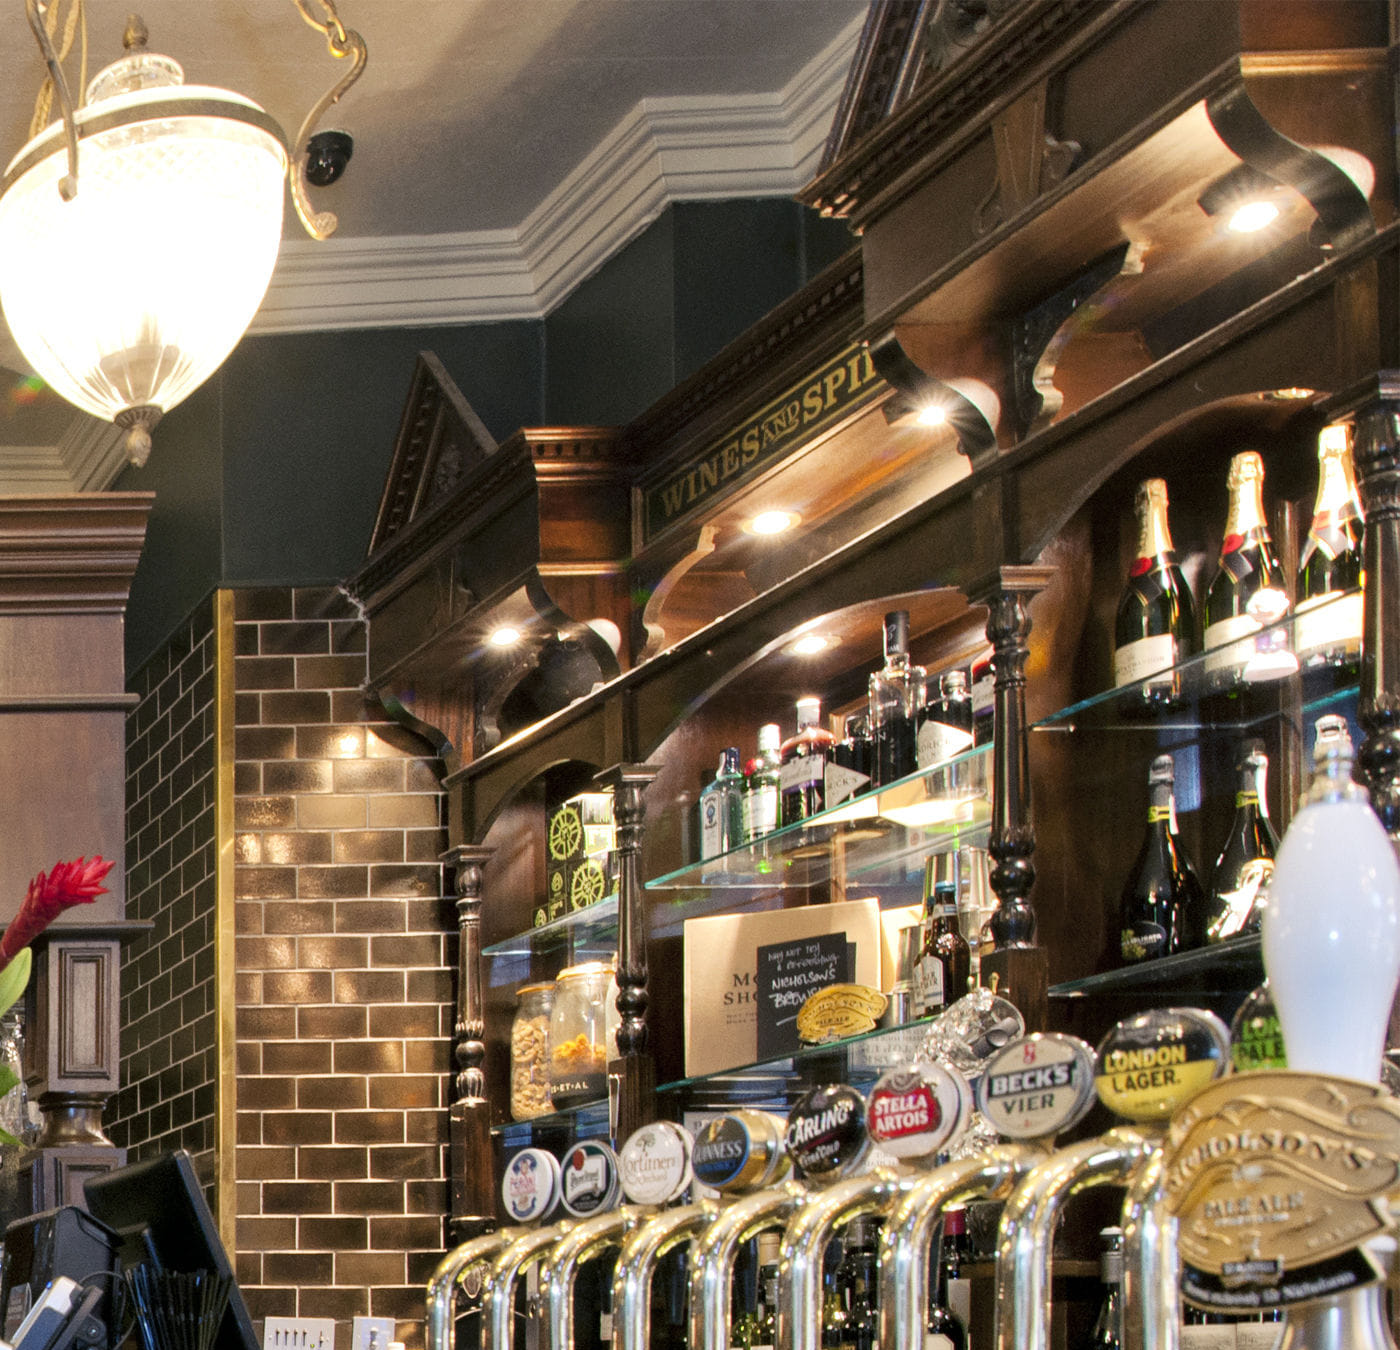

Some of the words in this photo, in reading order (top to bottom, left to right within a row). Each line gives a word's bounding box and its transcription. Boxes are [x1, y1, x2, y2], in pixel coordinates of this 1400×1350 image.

[662, 424, 761, 518] WINES
[761, 399, 800, 449] AND
[1104, 1044, 1186, 1073] LONDON
[992, 1063, 1069, 1096] BECK'S
[874, 1094, 928, 1116] STELLA
[1002, 1092, 1054, 1114] VIER
[786, 1106, 849, 1147] CARLING
[876, 1110, 928, 1132] ARTOIS
